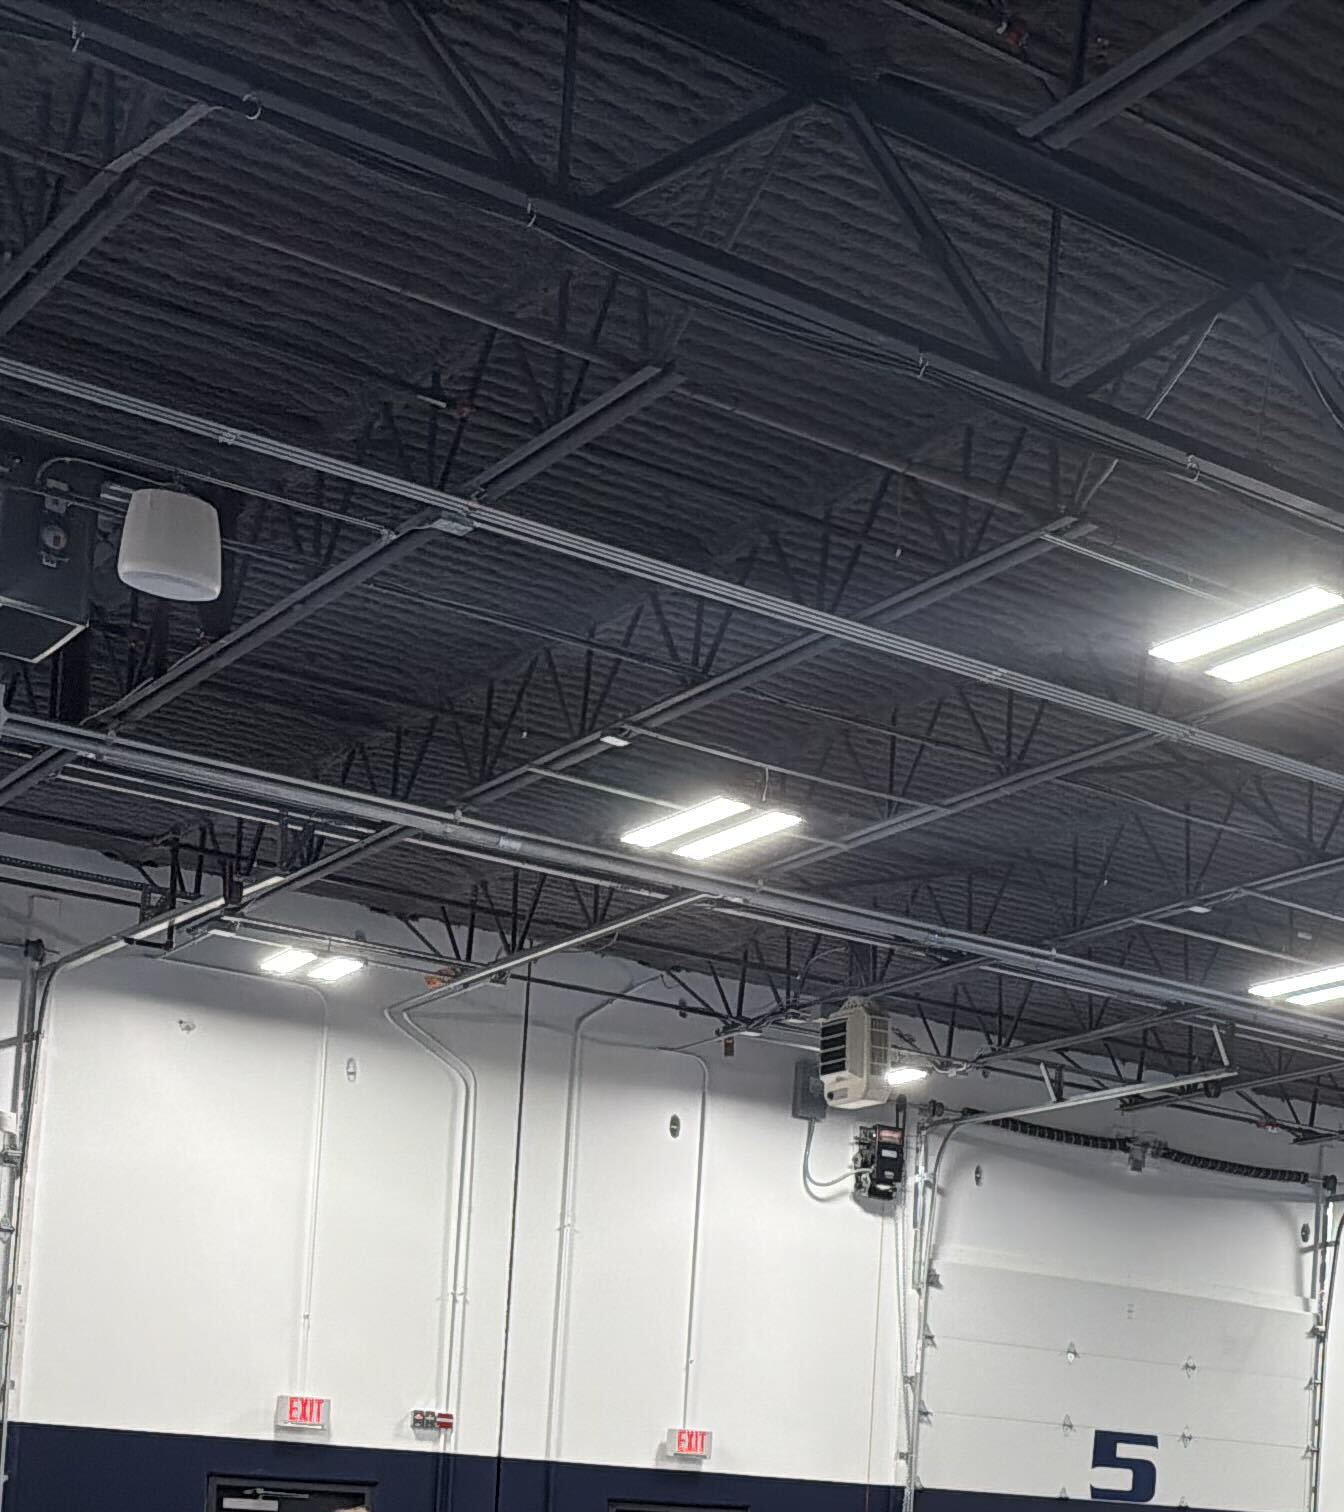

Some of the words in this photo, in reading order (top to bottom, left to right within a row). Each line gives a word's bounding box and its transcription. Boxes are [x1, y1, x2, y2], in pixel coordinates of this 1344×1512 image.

[288, 1396, 325, 1425] EXIT
[676, 1430, 707, 1454] EXIT
[1090, 1430, 1159, 1503] 5
